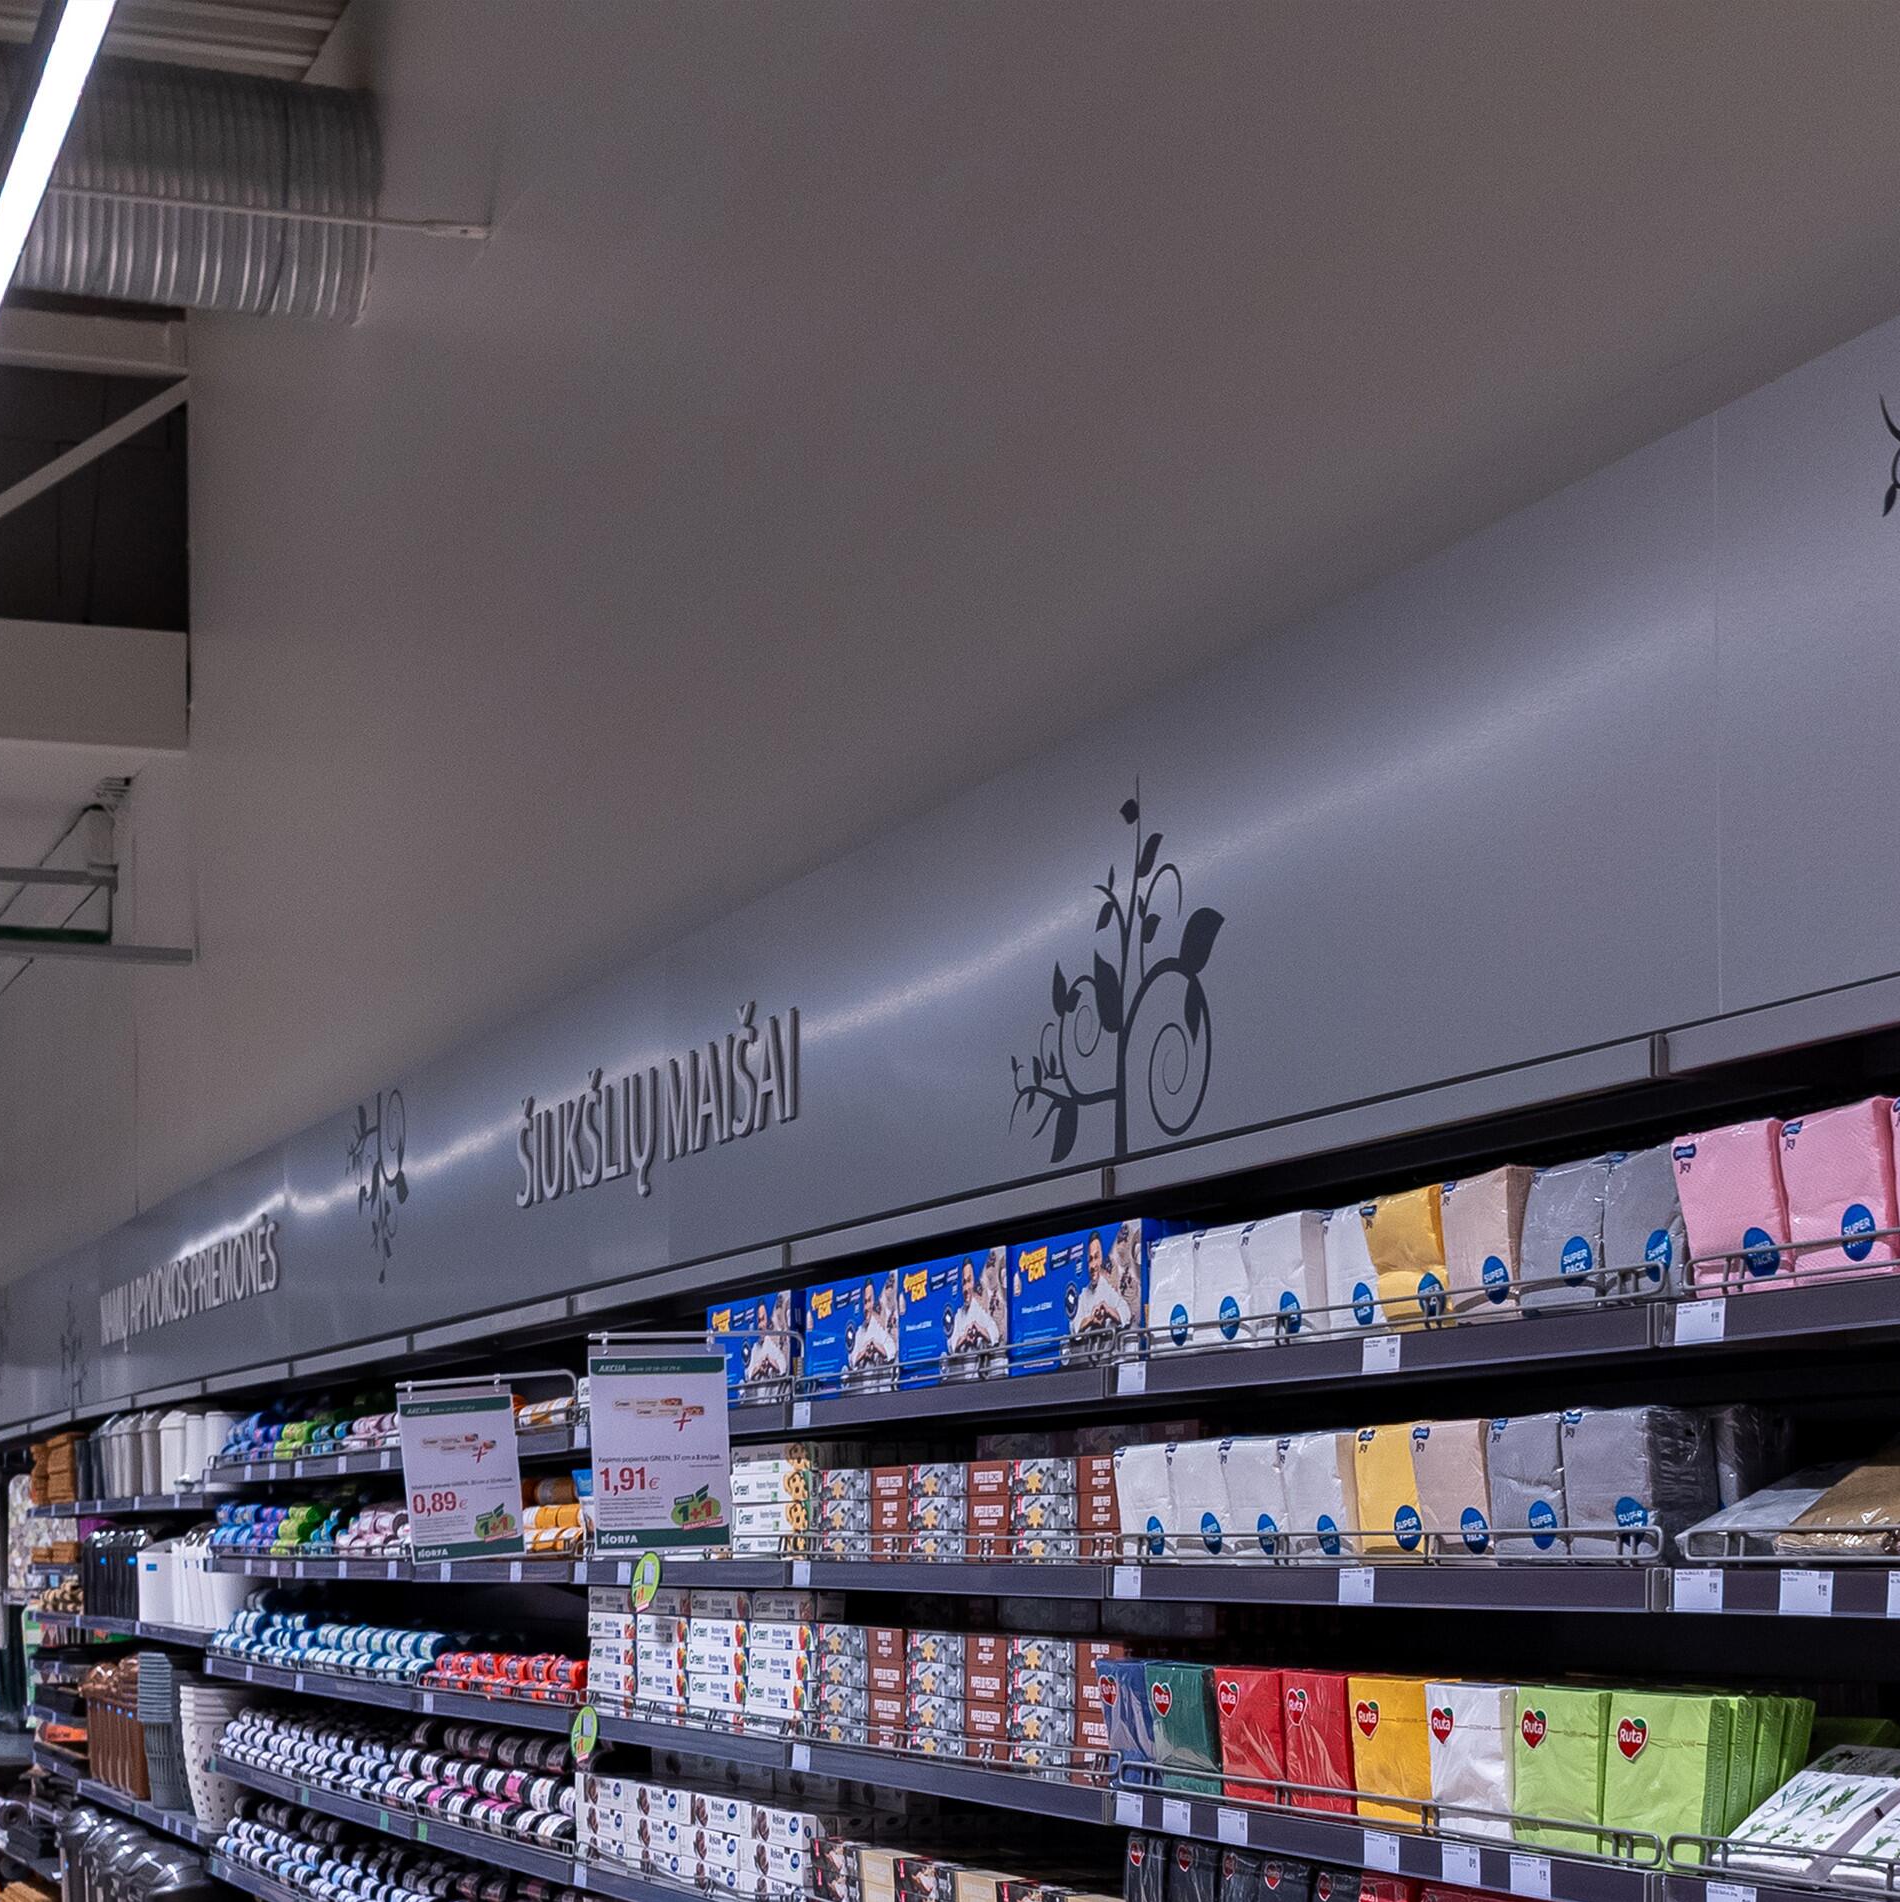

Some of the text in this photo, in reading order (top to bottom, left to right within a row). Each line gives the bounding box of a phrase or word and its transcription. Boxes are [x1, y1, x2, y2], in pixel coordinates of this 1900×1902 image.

[516, 1000, 801, 1208] ŠIUKŠLIŲ MAIŠAI
[1843, 1217, 1871, 1238] SUPER
[1563, 1250, 1589, 1266] SUPER
[1483, 1270, 1505, 1285] SUPER
[600, 1466, 645, 1496] 1,91
[413, 1491, 456, 1517] 0,89
[1395, 1517, 1419, 1532] SUPER
[1463, 1520, 1486, 1534] SUPER
[1530, 1514, 1555, 1529] SUPER
[752, 1624, 769, 1641] Green
[1357, 1709, 1379, 1724] Ruta
[1431, 1716, 1454, 1731] Ruta
[1522, 1720, 1546, 1735] Ruta
[1618, 1728, 1644, 1744] Ruta
